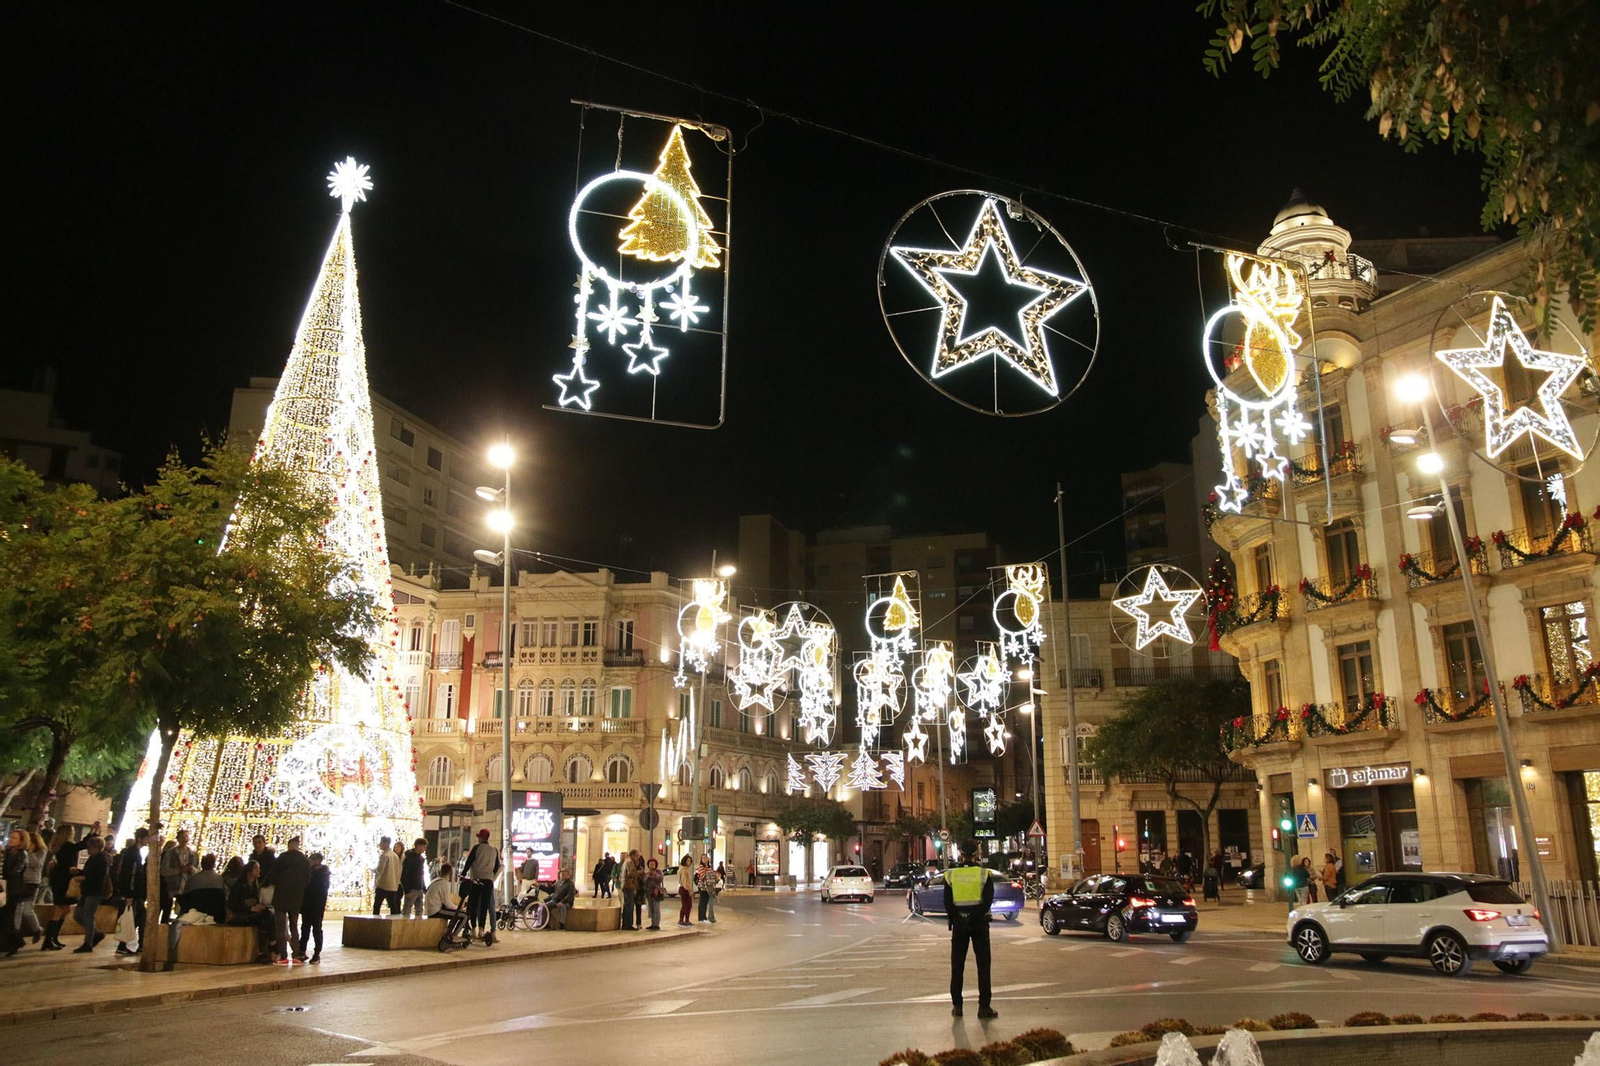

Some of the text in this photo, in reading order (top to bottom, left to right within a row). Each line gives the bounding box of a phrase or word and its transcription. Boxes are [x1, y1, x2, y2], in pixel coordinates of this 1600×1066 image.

[1351, 766, 1408, 785] cajamar
[512, 811, 553, 823] BLACK
[511, 821, 555, 834] FRIDAY
